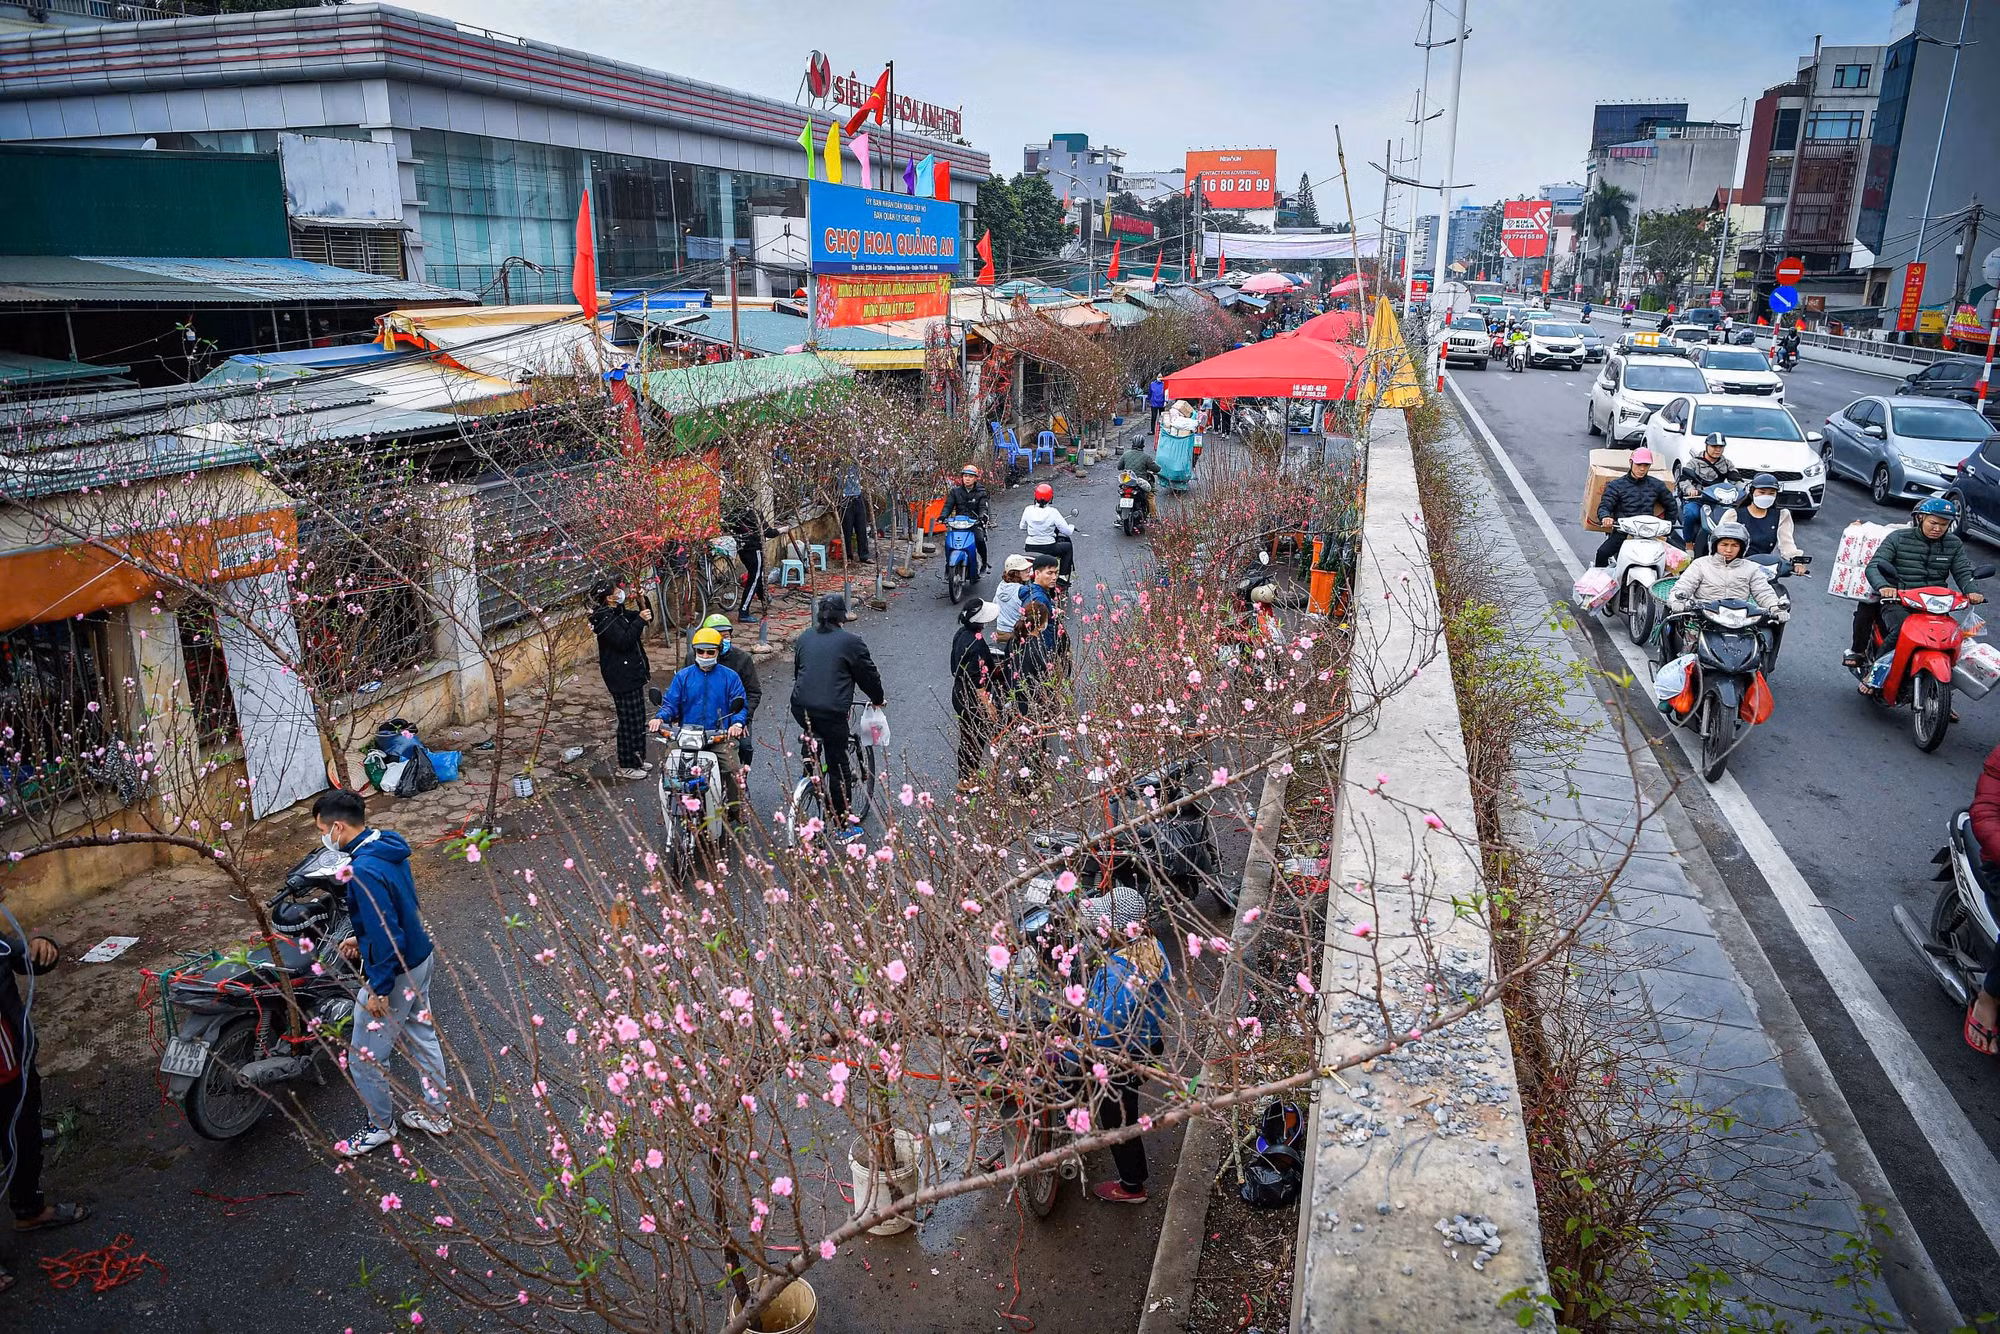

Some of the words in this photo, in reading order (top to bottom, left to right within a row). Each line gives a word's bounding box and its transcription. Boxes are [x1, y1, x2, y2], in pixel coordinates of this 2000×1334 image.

[1189, 179, 1217, 192] 016
[1220, 179, 1234, 192] 80
[1238, 179, 1252, 192] 20
[1256, 179, 1270, 192] 99
[825, 227, 861, 260] CHỢ
[864, 231, 894, 256] HOA
[896, 227, 938, 257] QUẢNG
[940, 237, 954, 256] AN
